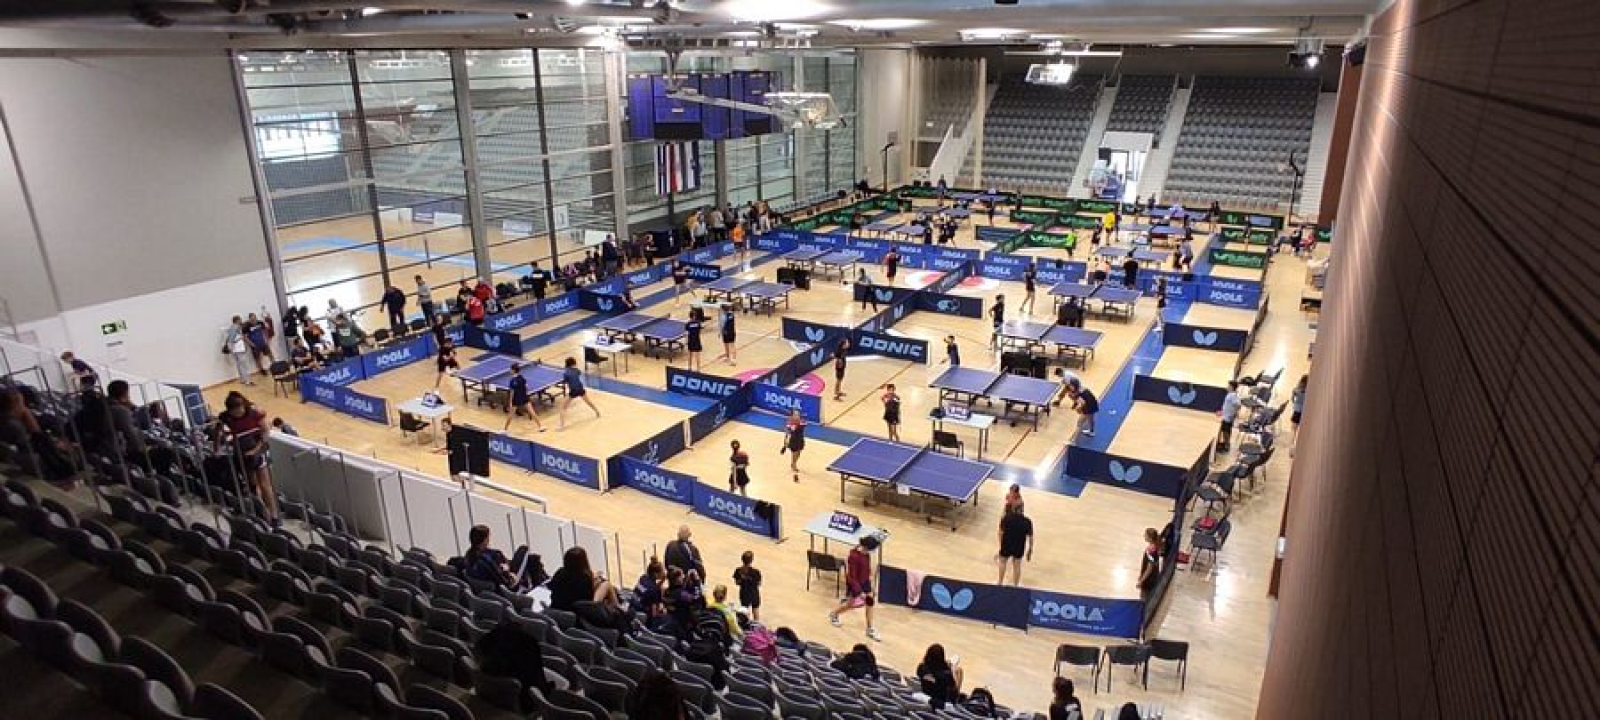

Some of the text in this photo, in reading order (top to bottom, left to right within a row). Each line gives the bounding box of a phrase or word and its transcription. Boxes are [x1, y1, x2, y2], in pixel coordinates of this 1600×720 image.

[984, 264, 1011, 277] JOOLA
[1210, 290, 1244, 303] JOOLA
[495, 313, 523, 329] JOOLA
[376, 347, 411, 366] JOOLA
[859, 335, 922, 357] DONIC
[671, 374, 738, 397] DONIC
[765, 390, 803, 411] JOOLA
[541, 452, 582, 474] JOOLA
[634, 468, 677, 493] JOOLA
[708, 495, 755, 521] JOOLA
[1032, 600, 1104, 622] JOOLA
